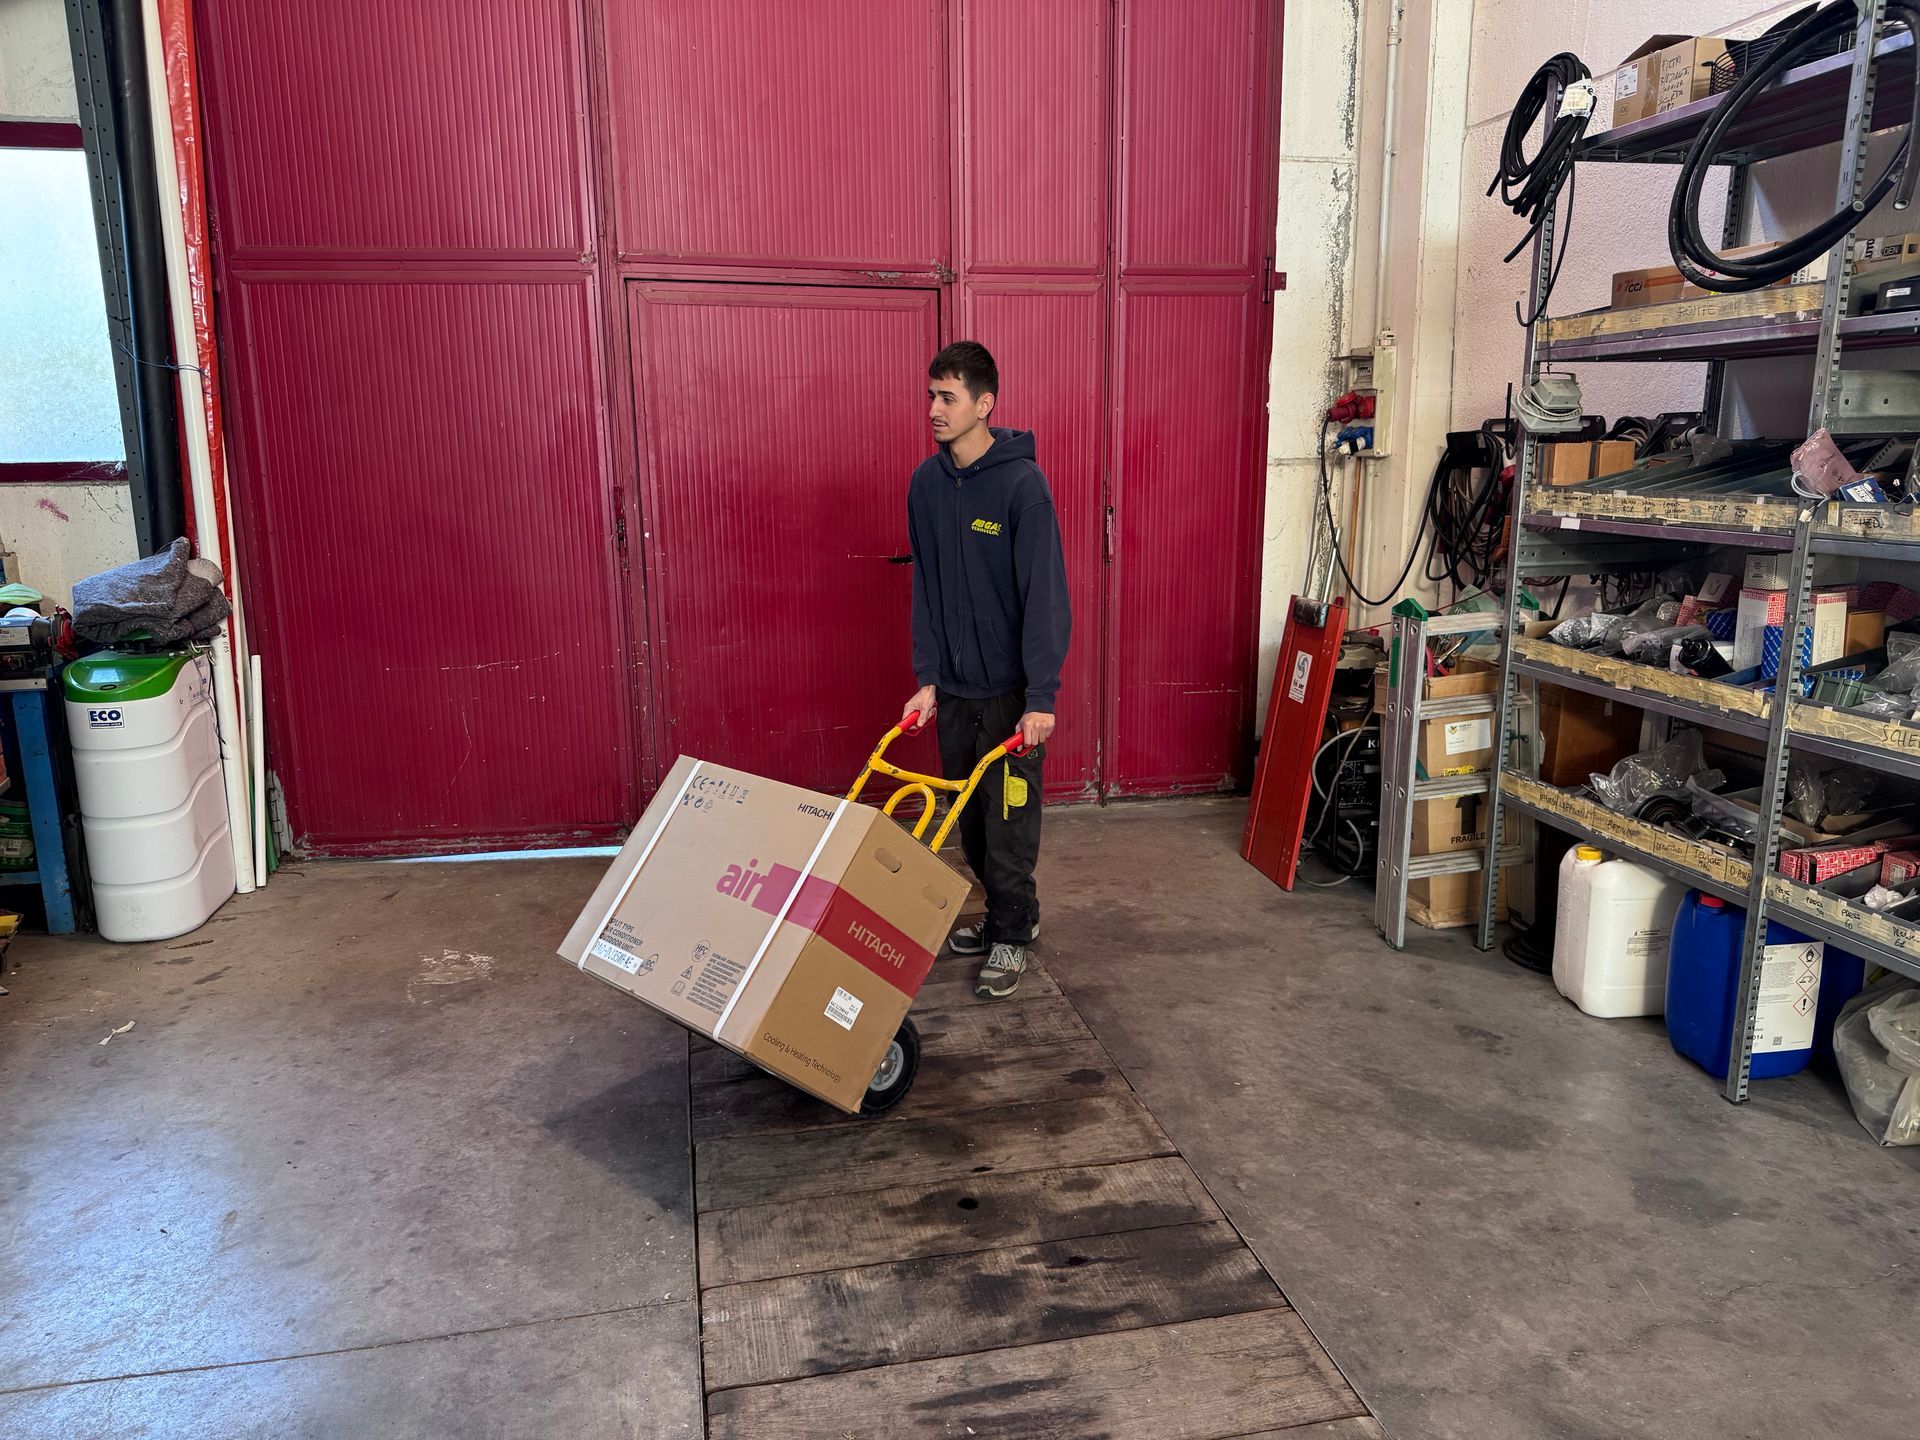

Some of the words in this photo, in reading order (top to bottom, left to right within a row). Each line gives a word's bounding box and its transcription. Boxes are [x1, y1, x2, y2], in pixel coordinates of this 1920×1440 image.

[90, 710, 121, 721] ECO
[1882, 724, 1920, 748] SCHE
[797, 803, 835, 821] HITACHI
[1450, 832, 1486, 844] FRAGILE
[1841, 908, 1861, 920] PRESS
[612, 929, 643, 946] CONDITIONER
[847, 920, 905, 969] HITACHI
[763, 1032, 786, 1052] Cooling
[790, 1047, 812, 1067] Heating
[811, 1059, 841, 1083] Technology
